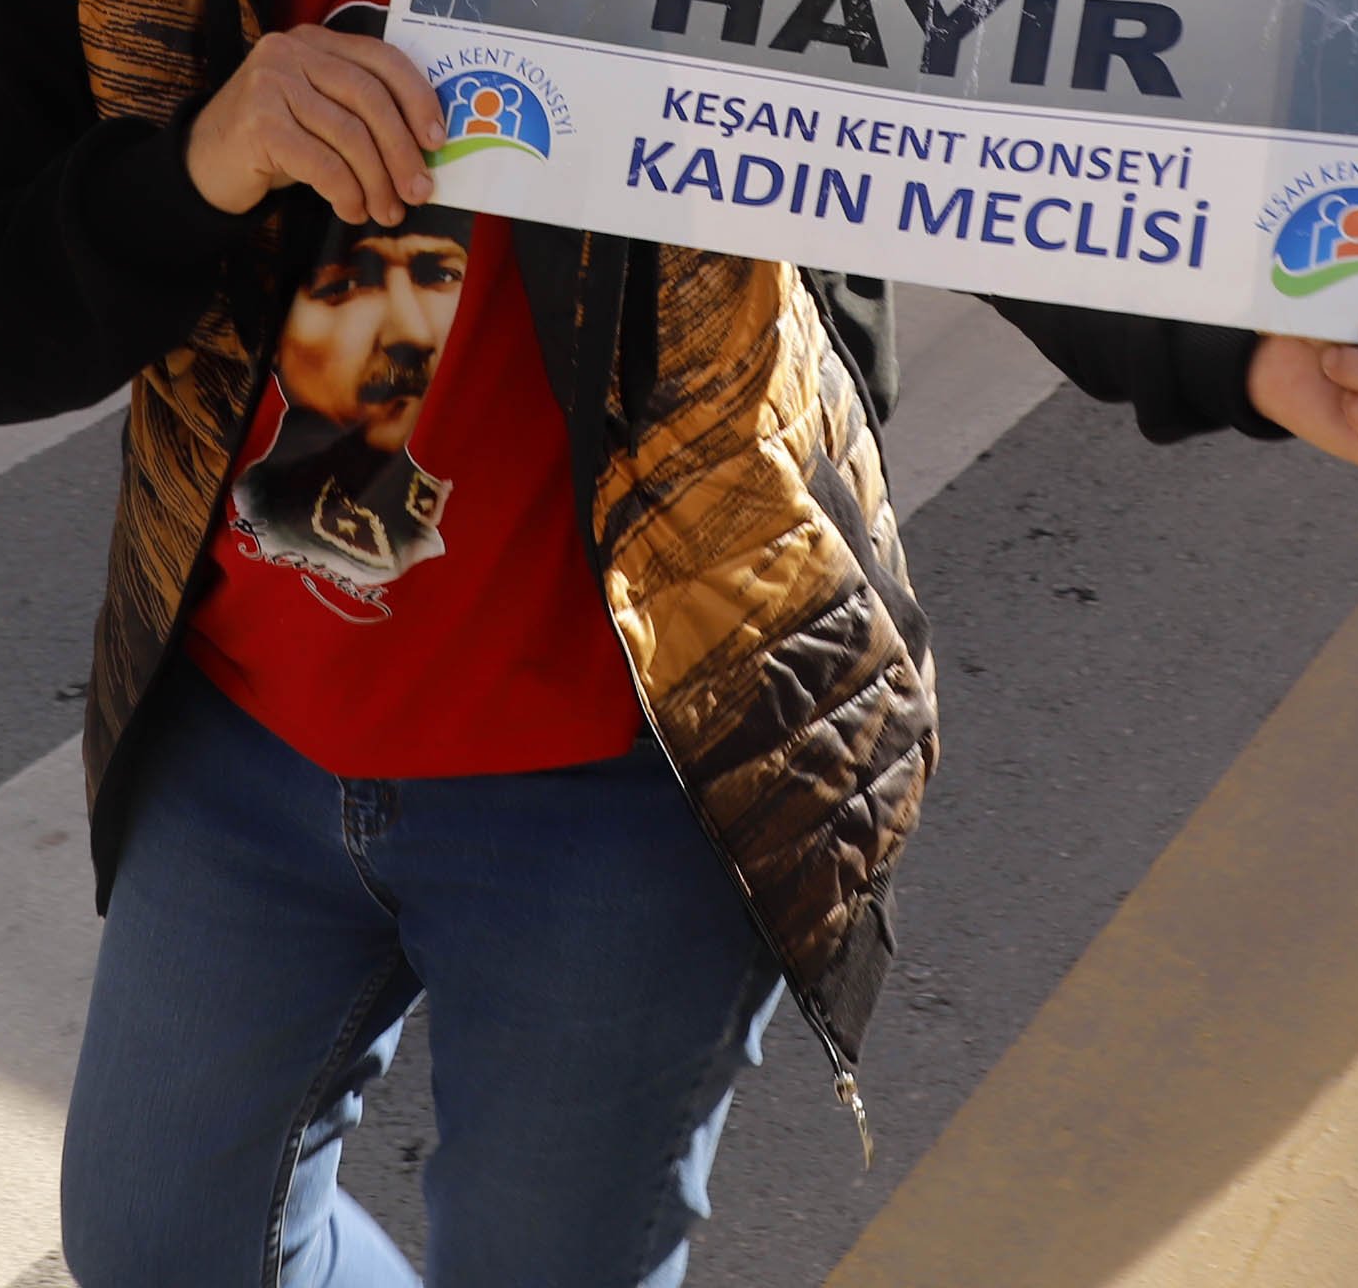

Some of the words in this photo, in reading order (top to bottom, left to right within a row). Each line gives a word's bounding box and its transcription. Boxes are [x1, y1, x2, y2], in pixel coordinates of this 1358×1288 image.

[458, 47, 516, 69] KENT
[515, 56, 578, 136] KONSEYİ
[661, 86, 820, 139] KEŞAN
[836, 114, 966, 165] KENT
[978, 135, 1194, 192] KONSEYİ
[627, 136, 873, 225] KADIN
[897, 180, 1212, 269] MECLİSİ
